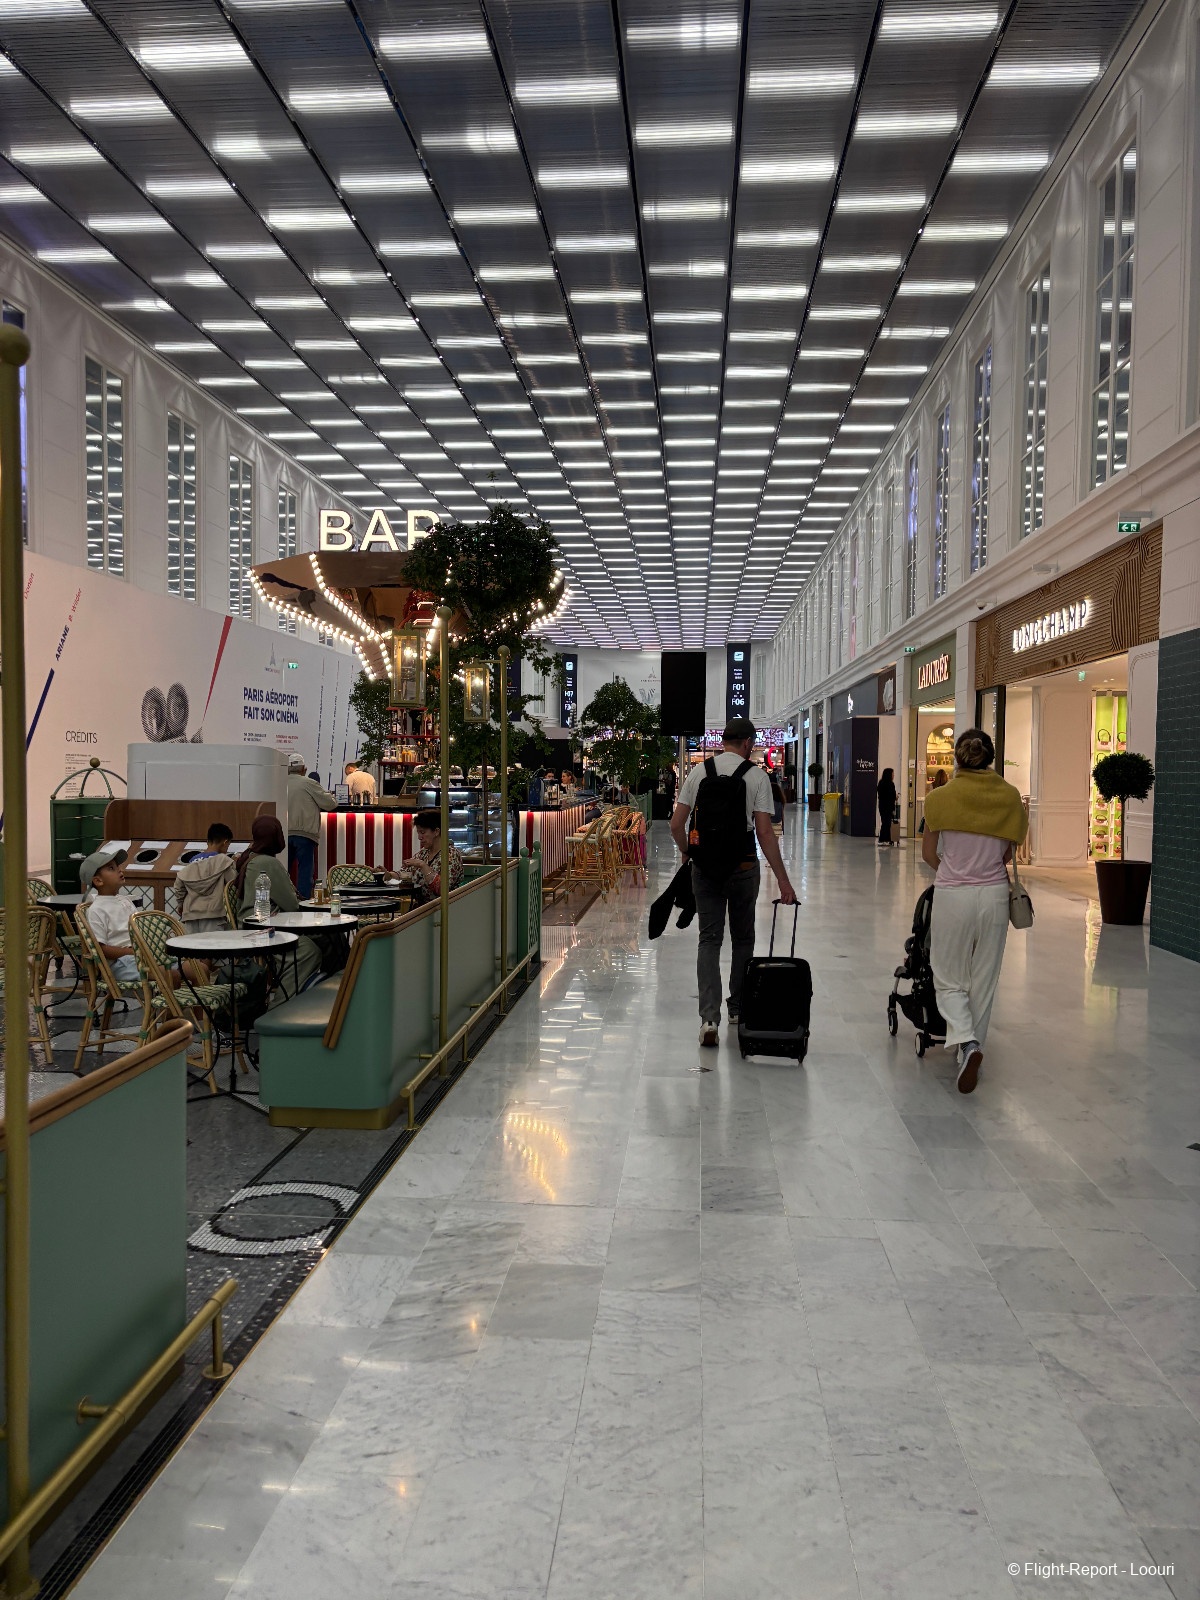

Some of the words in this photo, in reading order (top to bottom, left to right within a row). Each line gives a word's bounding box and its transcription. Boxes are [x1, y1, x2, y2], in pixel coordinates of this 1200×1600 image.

[1012, 599, 1091, 653] LONGCHAMP
[55, 625, 69, 661] ARIANE
[917, 653, 949, 690] LADURÉE
[243, 686, 264, 703] PARIS
[265, 688, 299, 707] AÉROPORT
[732, 683, 745, 691] F01
[731, 698, 745, 706] F06
[243, 705, 259, 720] FAIT
[260, 707, 275, 722] SON
[276, 708, 299, 724] CINÉMA
[65, 728, 98, 744] CRÉDITS
